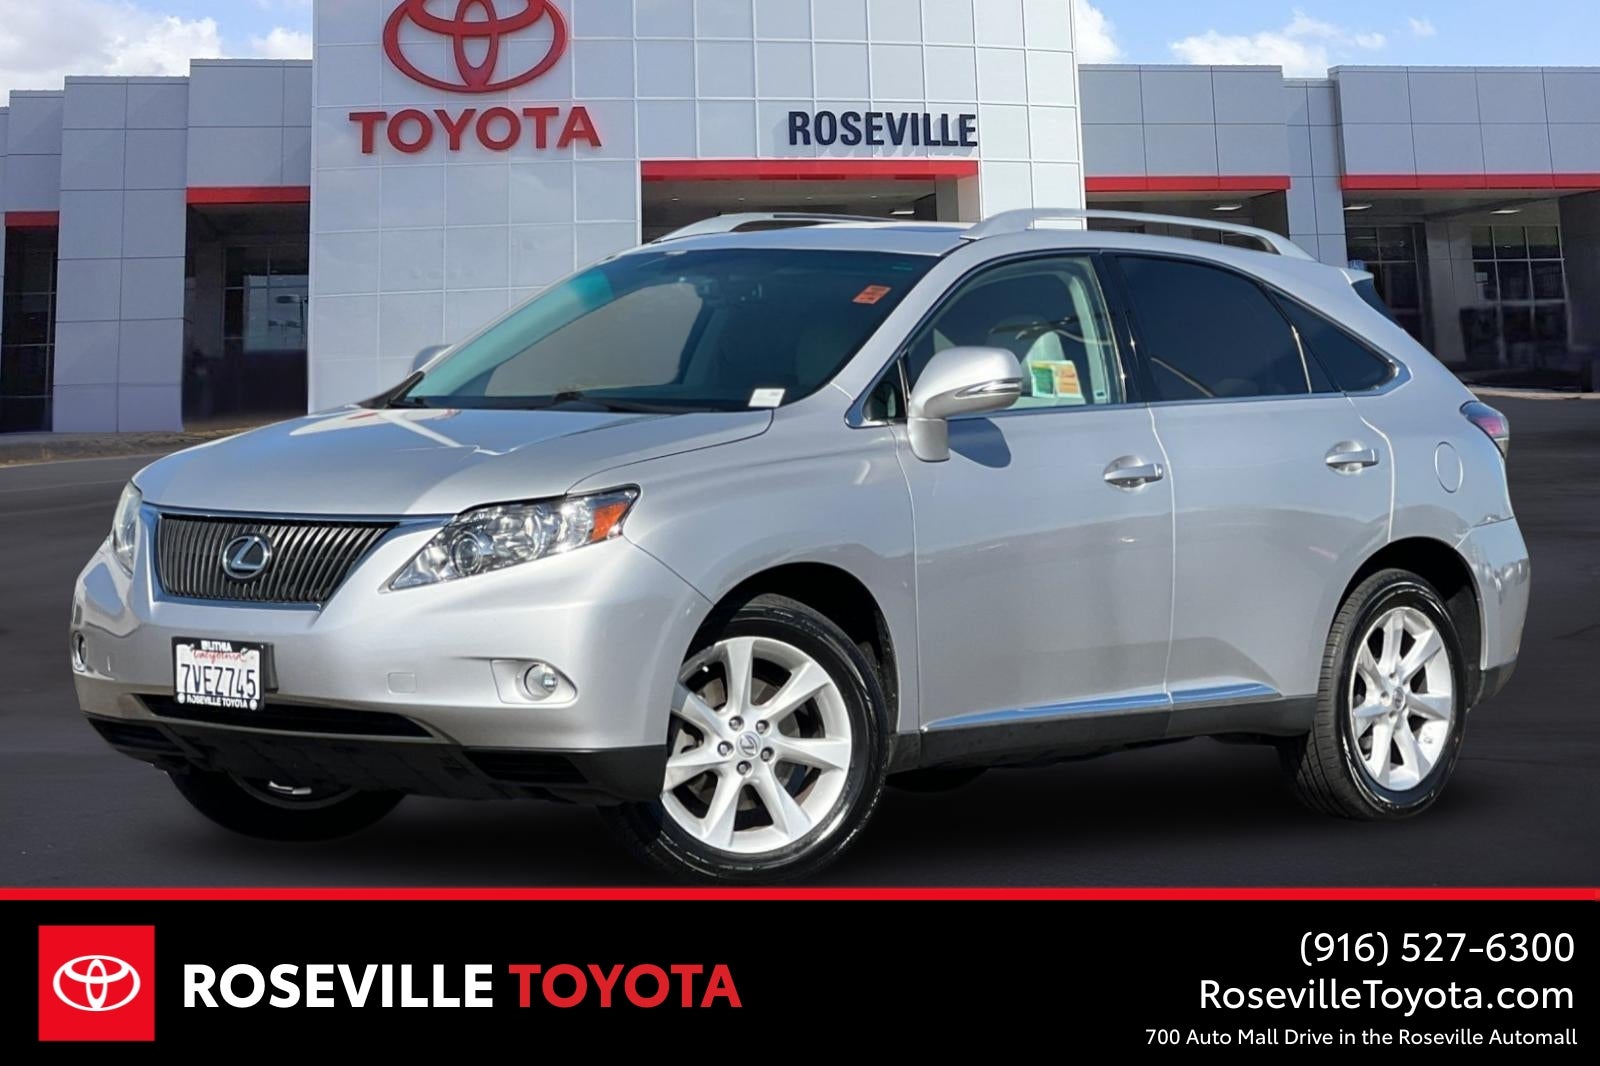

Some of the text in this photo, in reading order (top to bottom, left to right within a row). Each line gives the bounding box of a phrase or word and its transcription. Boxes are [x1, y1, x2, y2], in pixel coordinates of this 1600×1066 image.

[349, 106, 602, 154] TOYOTA
[788, 110, 978, 147] ROSEVILLE
[180, 663, 256, 699] 7VEZ745
[186, 695, 248, 709] ROSEVILLE TOYOTA
